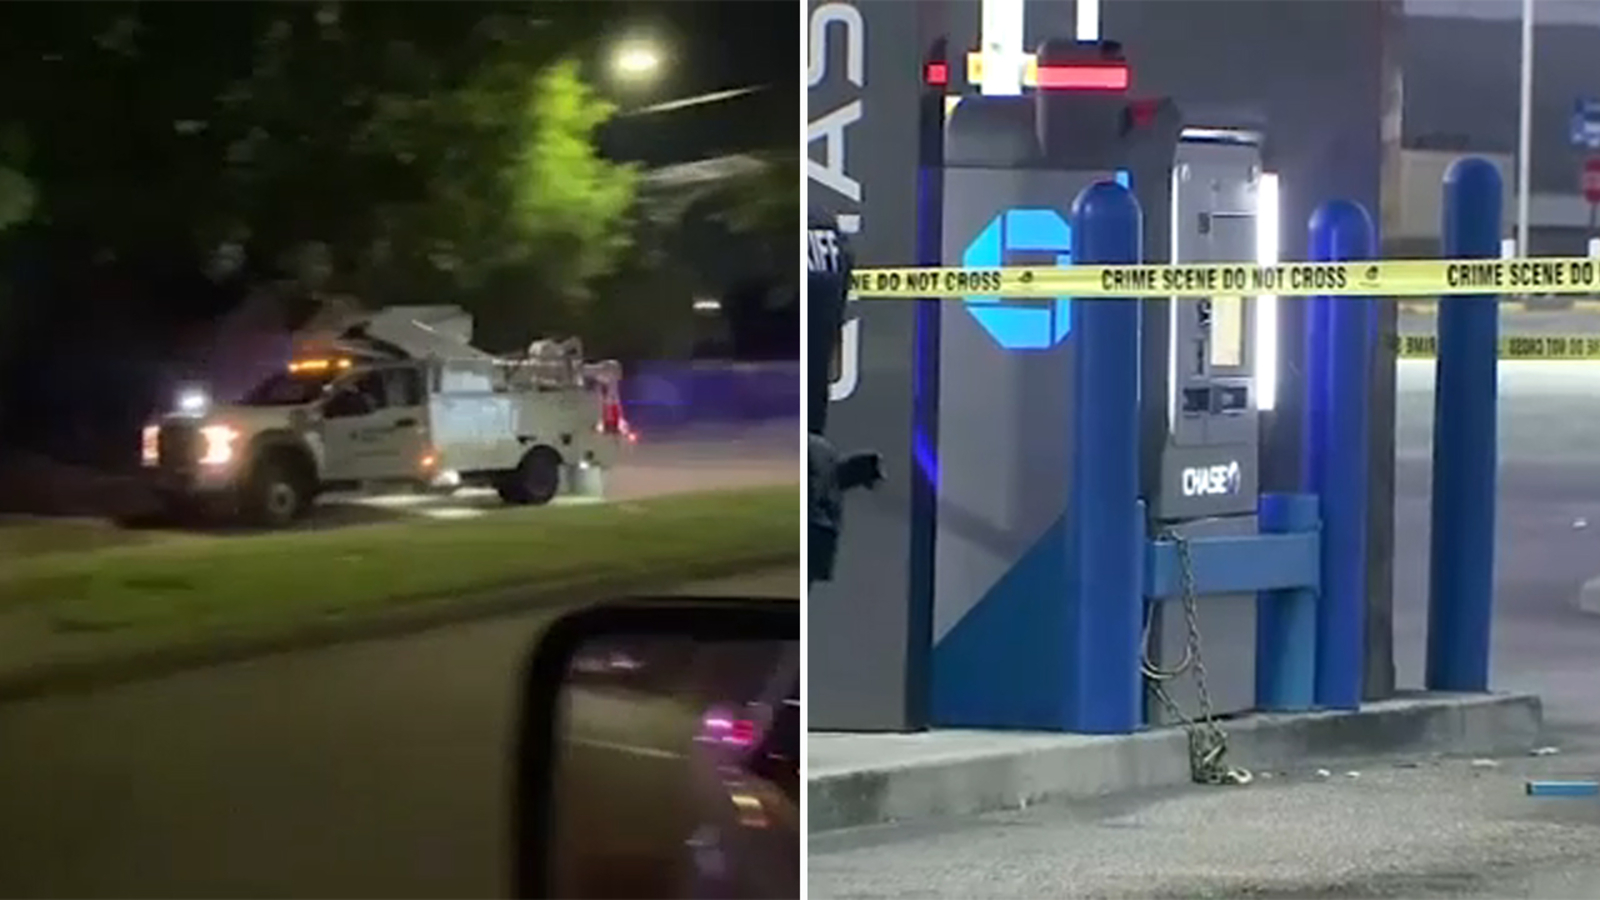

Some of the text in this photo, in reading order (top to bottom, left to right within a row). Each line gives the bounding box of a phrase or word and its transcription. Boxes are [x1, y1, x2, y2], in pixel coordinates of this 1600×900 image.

[877, 272, 900, 290] DO
[907, 272, 939, 290] NOT
[944, 271, 1001, 290] CROSS
[1101, 265, 1347, 290] CRIME SCENE DO NOT CROSS
[1447, 262, 1593, 287] CRIME SCENE DO
[1182, 465, 1229, 496] CHASE
